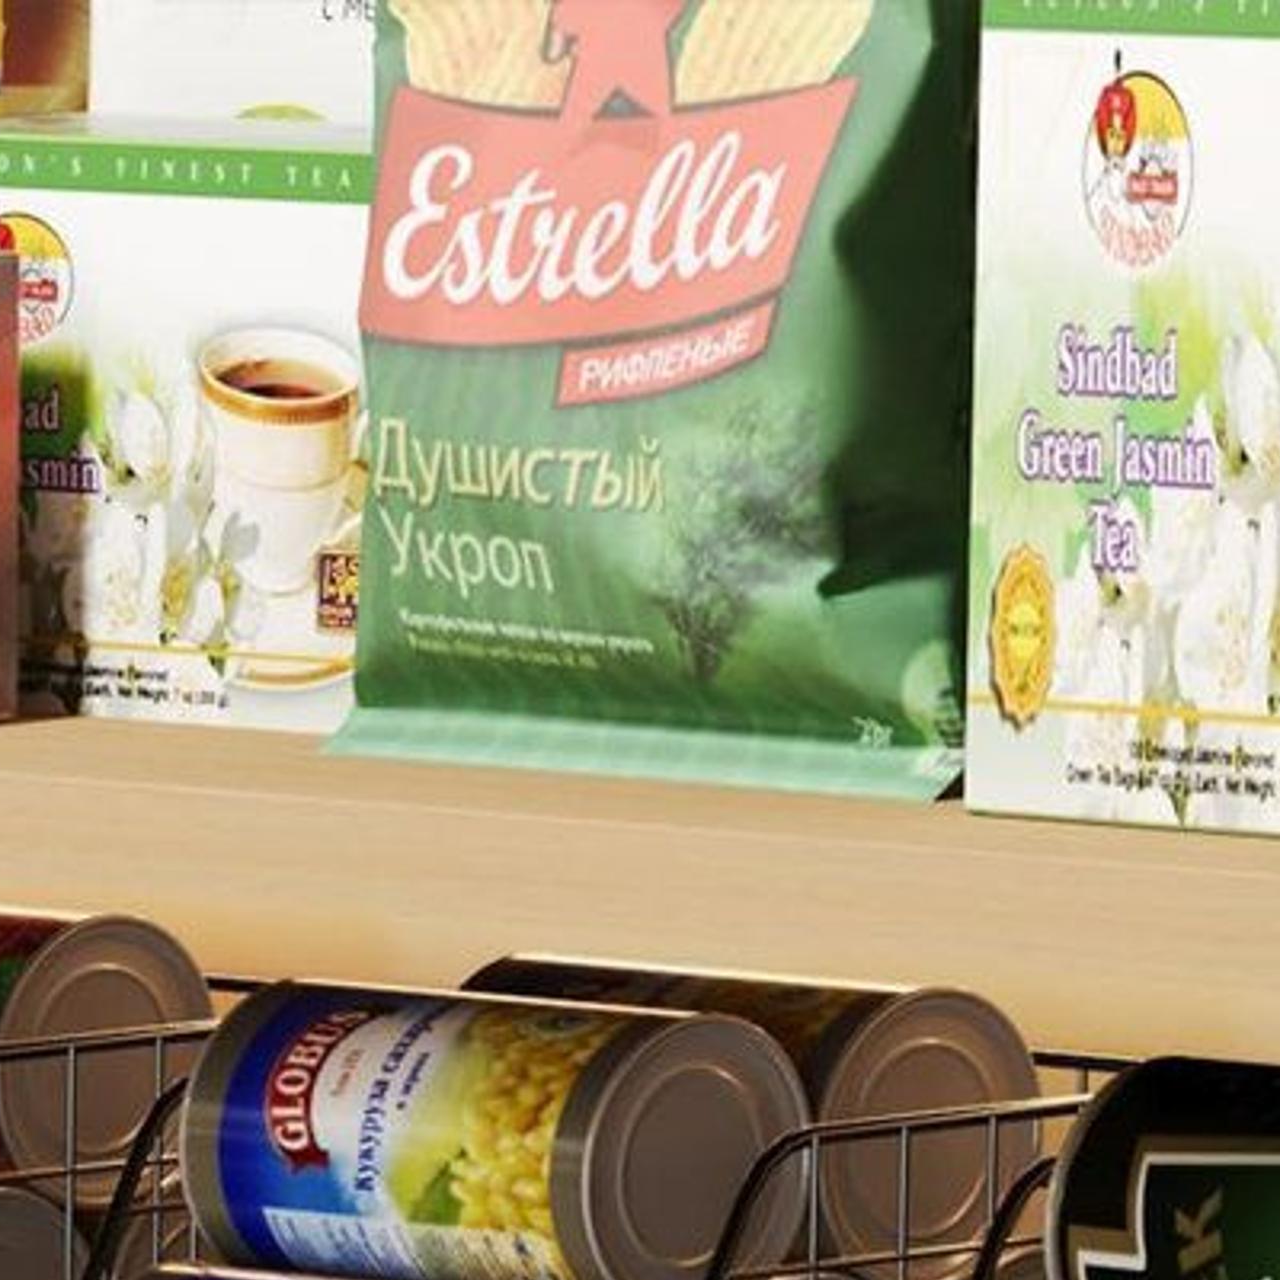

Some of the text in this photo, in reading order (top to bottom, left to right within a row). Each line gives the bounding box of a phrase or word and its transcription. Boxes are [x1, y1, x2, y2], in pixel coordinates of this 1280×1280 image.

[285, 164, 354, 190] TEA
[382, 131, 787, 304] Estrella
[1056, 323, 1179, 398] Sindbad
[373, 417, 665, 512] Душистый
[1015, 408, 1217, 504] Green Jasmin
[380, 508, 555, 598] Укроп
[1087, 497, 1140, 573] Tea
[272, 1012, 369, 1150] GLOBUS
